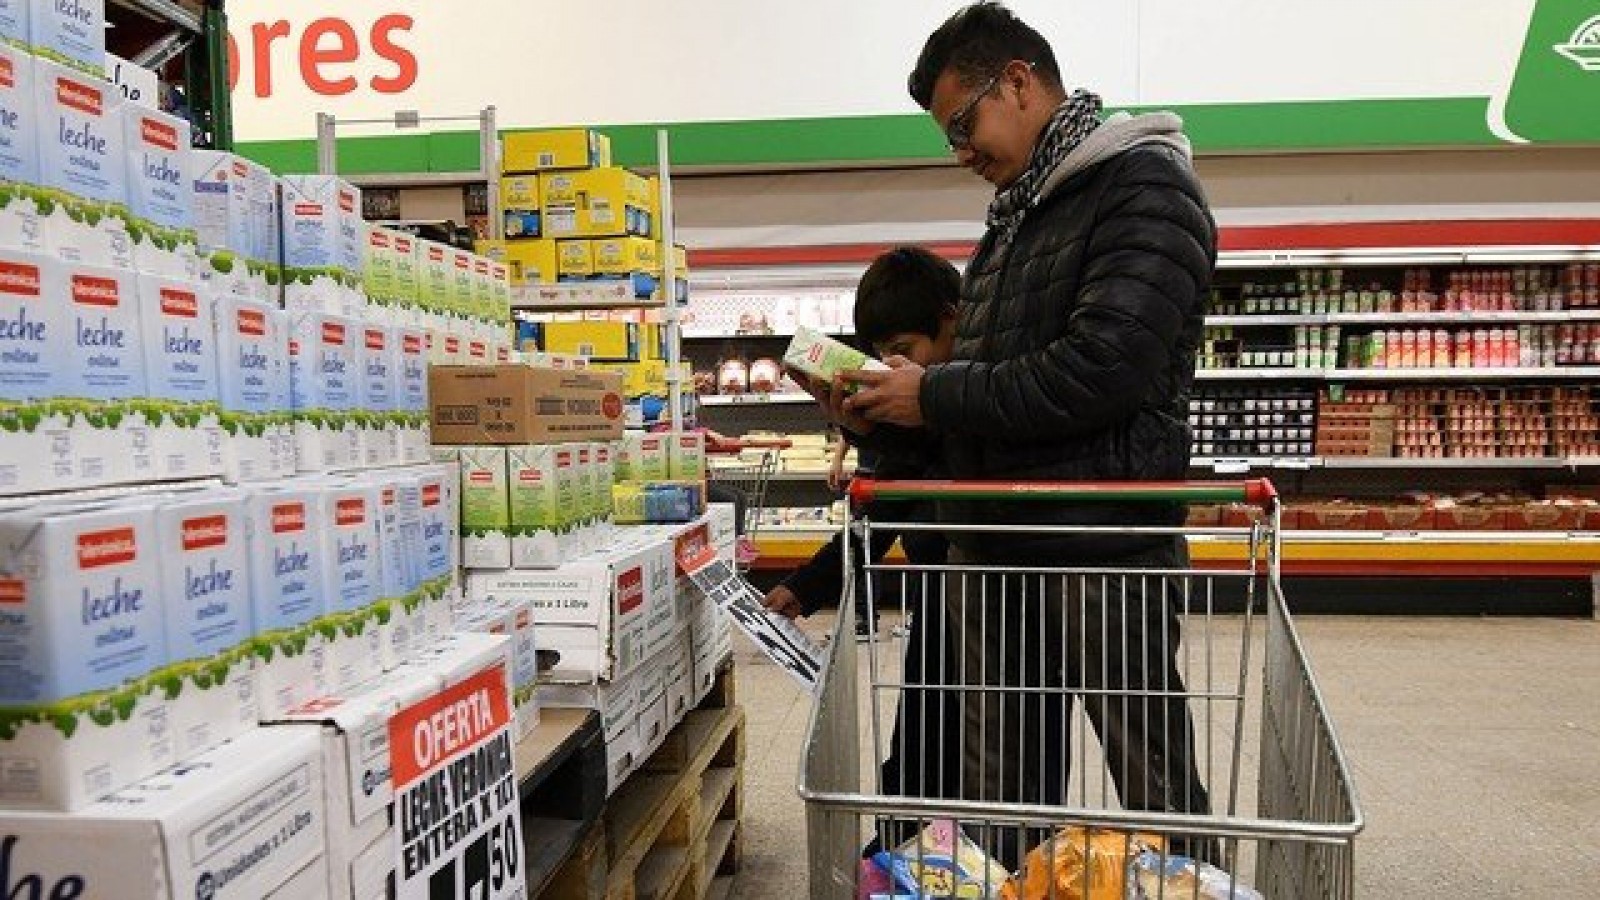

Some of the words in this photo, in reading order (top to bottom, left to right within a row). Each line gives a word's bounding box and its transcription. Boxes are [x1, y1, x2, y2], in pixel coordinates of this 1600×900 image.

[227, 13, 418, 98] res
[59, 116, 106, 155] leche
[144, 152, 180, 185] leche
[77, 316, 124, 348] leche
[164, 326, 203, 355] leche
[239, 345, 267, 370] leche
[275, 541, 308, 577] leche
[337, 533, 366, 565] leche
[185, 557, 234, 600] leche
[82, 577, 143, 625] leche
[413, 688, 492, 769] OFERTA
[402, 768, 449, 846] LECHE
[402, 802, 478, 880] ENTERA
[479, 789, 491, 823] X
[491, 814, 517, 891] 50
